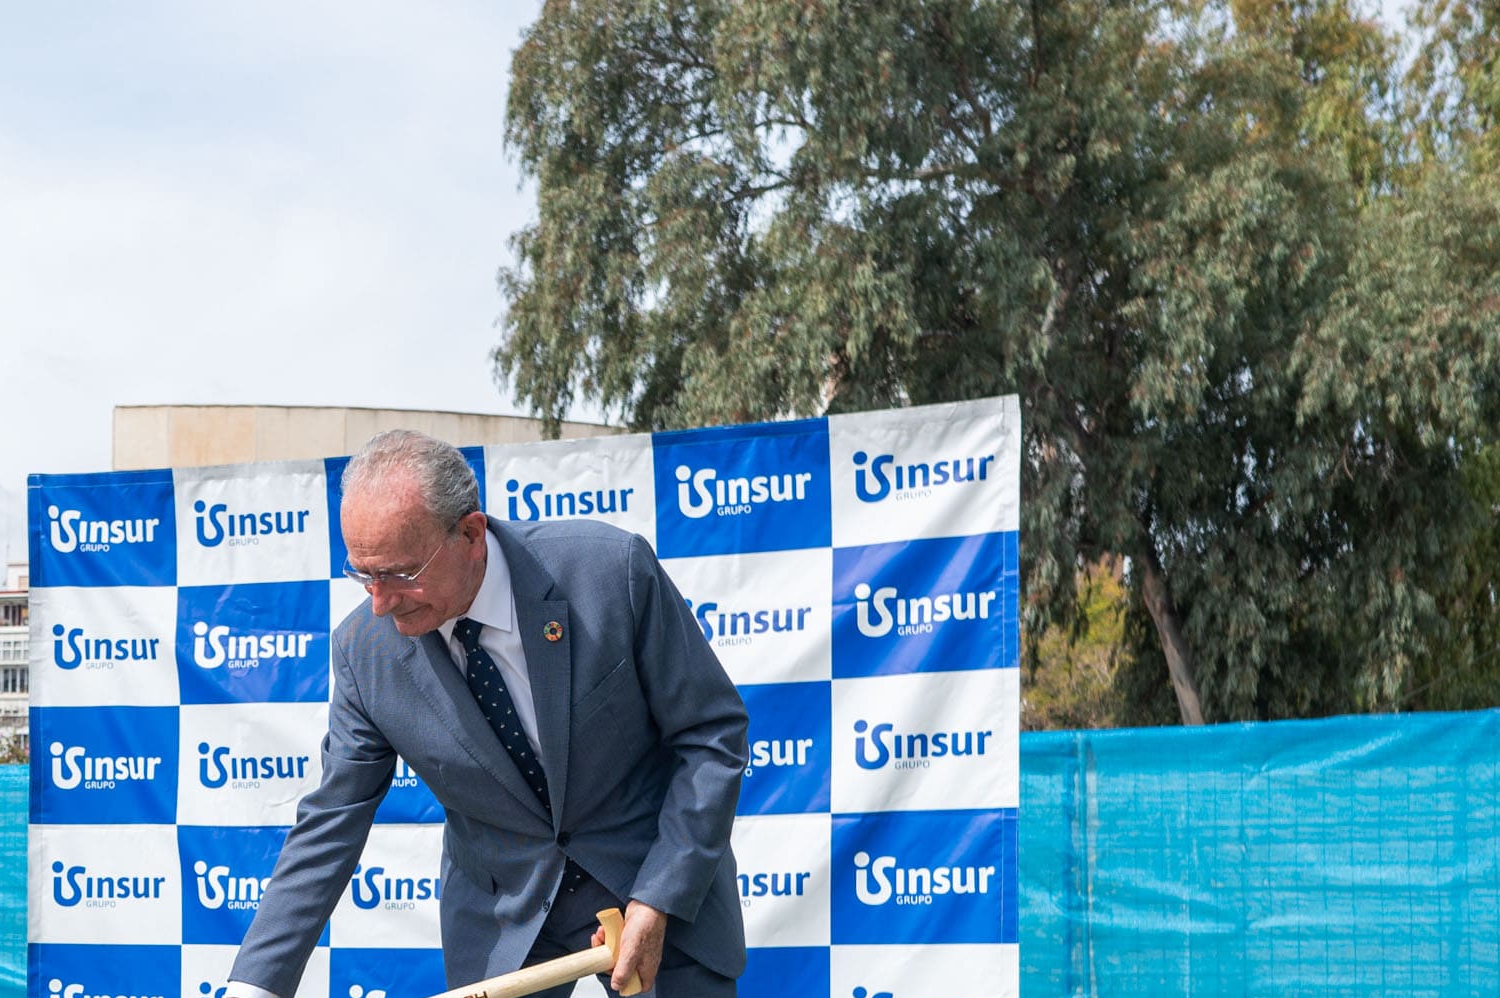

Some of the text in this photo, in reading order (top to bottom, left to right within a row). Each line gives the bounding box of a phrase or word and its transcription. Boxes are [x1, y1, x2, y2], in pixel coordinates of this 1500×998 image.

[896, 488, 932, 501] GRUPO
[716, 505, 752, 517] GRUPO
[228, 538, 260, 547] GRUPO
[79, 543, 110, 553] GRUPO
[897, 623, 934, 637] GRUPO
[717, 635, 753, 647] GRUPO
[85, 661, 115, 670] GRUPO
[227, 660, 260, 669] GRUPO
[894, 759, 931, 770] GRUPO
[84, 781, 116, 790] GRUPO
[231, 781, 261, 790] GRUPO
[391, 778, 418, 788] RUPO
[86, 900, 116, 909] GRUPO
[896, 895, 933, 905] GRUPO
[384, 902, 416, 911] GRUPO
